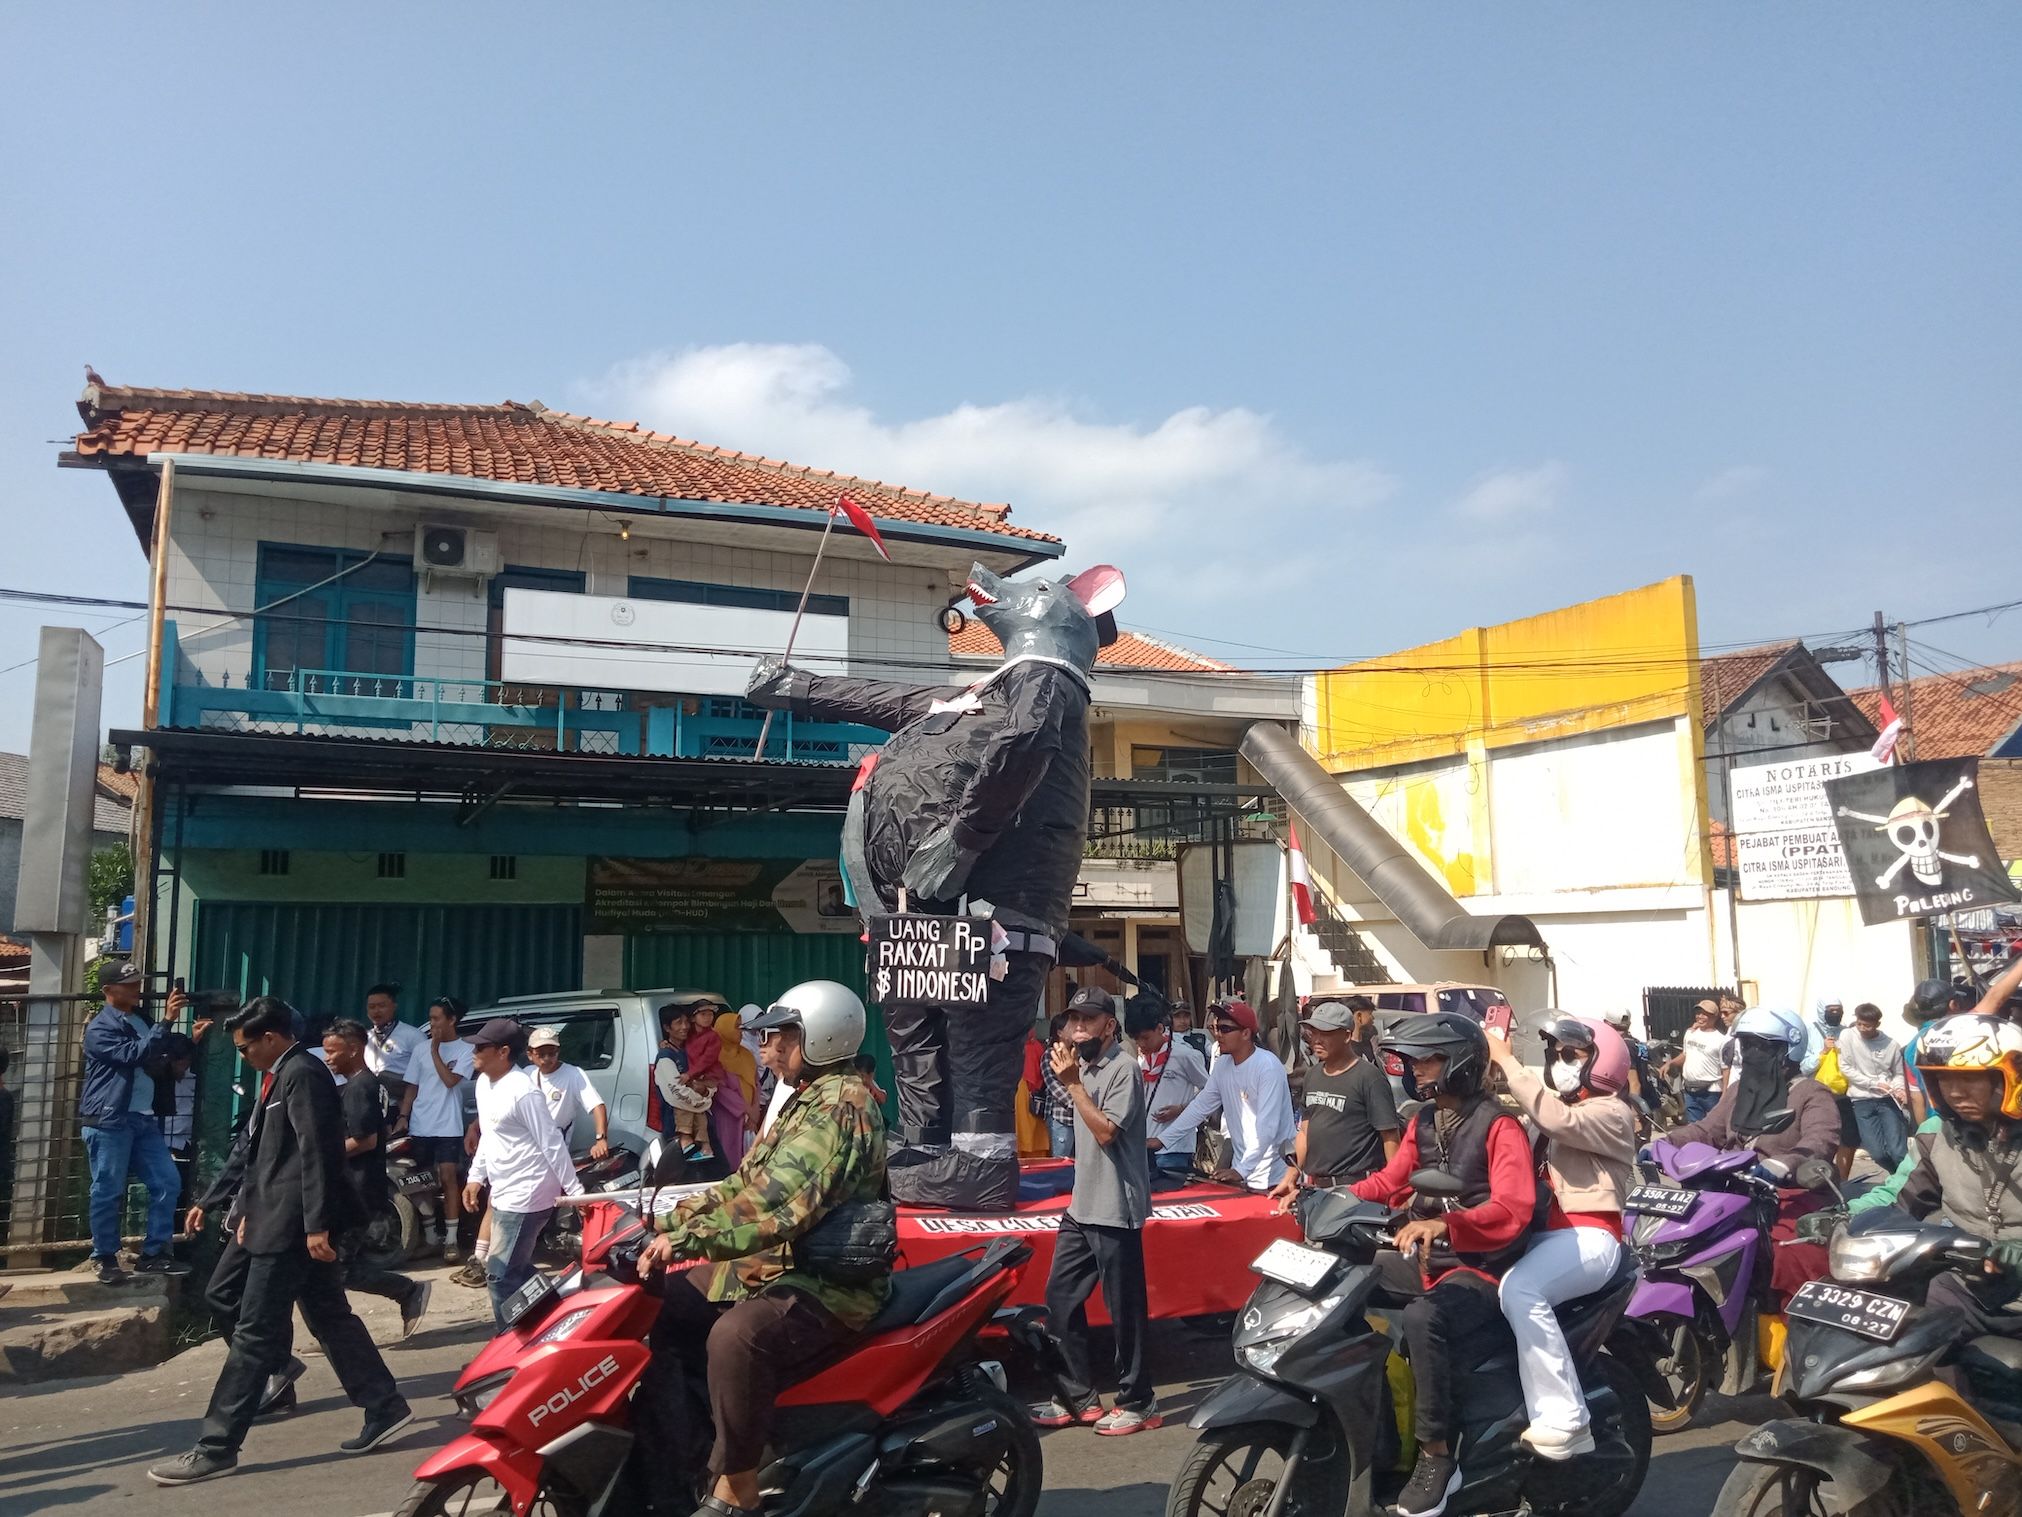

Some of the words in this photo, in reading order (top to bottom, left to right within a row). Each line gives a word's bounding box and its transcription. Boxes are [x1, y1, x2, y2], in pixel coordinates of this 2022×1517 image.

[1766, 761, 1852, 783] NOTARIS
[1762, 785, 1782, 796] ISMA
[1740, 836, 1779, 849] PEJABAT
[1782, 833, 1827, 845] PEMBUAT
[1782, 844, 1843, 858] (PPAT
[1743, 863, 1766, 873] CITRA
[1768, 860, 1790, 871] ISMA
[889, 919, 940, 941] UANG
[880, 941, 949, 967] RAKYAT
[897, 969, 987, 1002] INDONESIA
[1670, 1192, 1693, 1203] AAZ
[920, 1218, 994, 1232] DESA
[1818, 1287, 1863, 1309] 3329
[1866, 1299, 1903, 1321] CZN
[527, 1354, 620, 1428] POLICE
